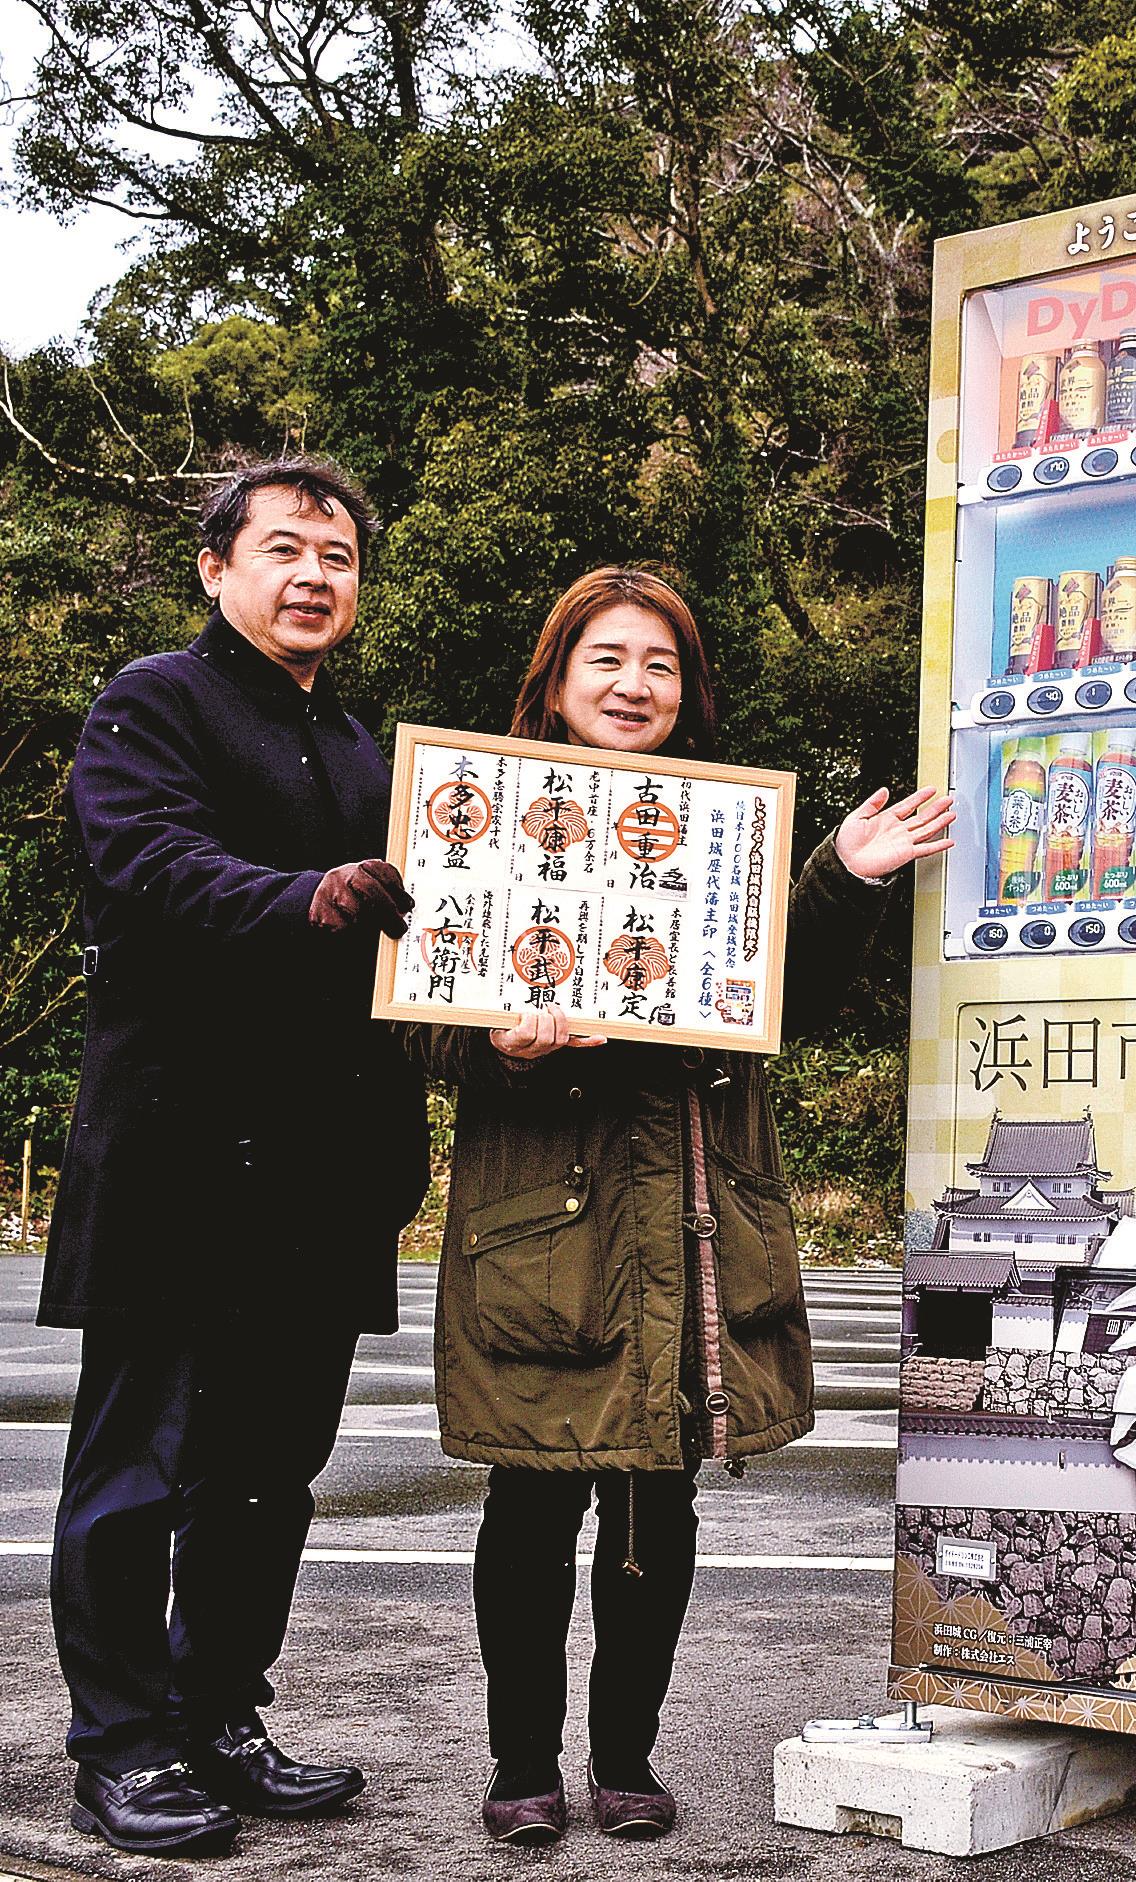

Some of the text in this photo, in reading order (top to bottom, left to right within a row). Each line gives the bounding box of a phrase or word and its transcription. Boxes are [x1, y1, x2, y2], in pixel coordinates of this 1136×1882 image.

[537, 767, 573, 882] 松平康福
[629, 776, 664, 891] 古田重治
[676, 777, 692, 847] 初代浜田藩主
[1053, 782, 1076, 824] 麦茶
[1101, 778, 1124, 821] 麦茶
[702, 808, 726, 939] 浜田城歴代藩主印
[427, 895, 464, 1003] 八右衛門
[618, 905, 655, 1020] 松平康定
